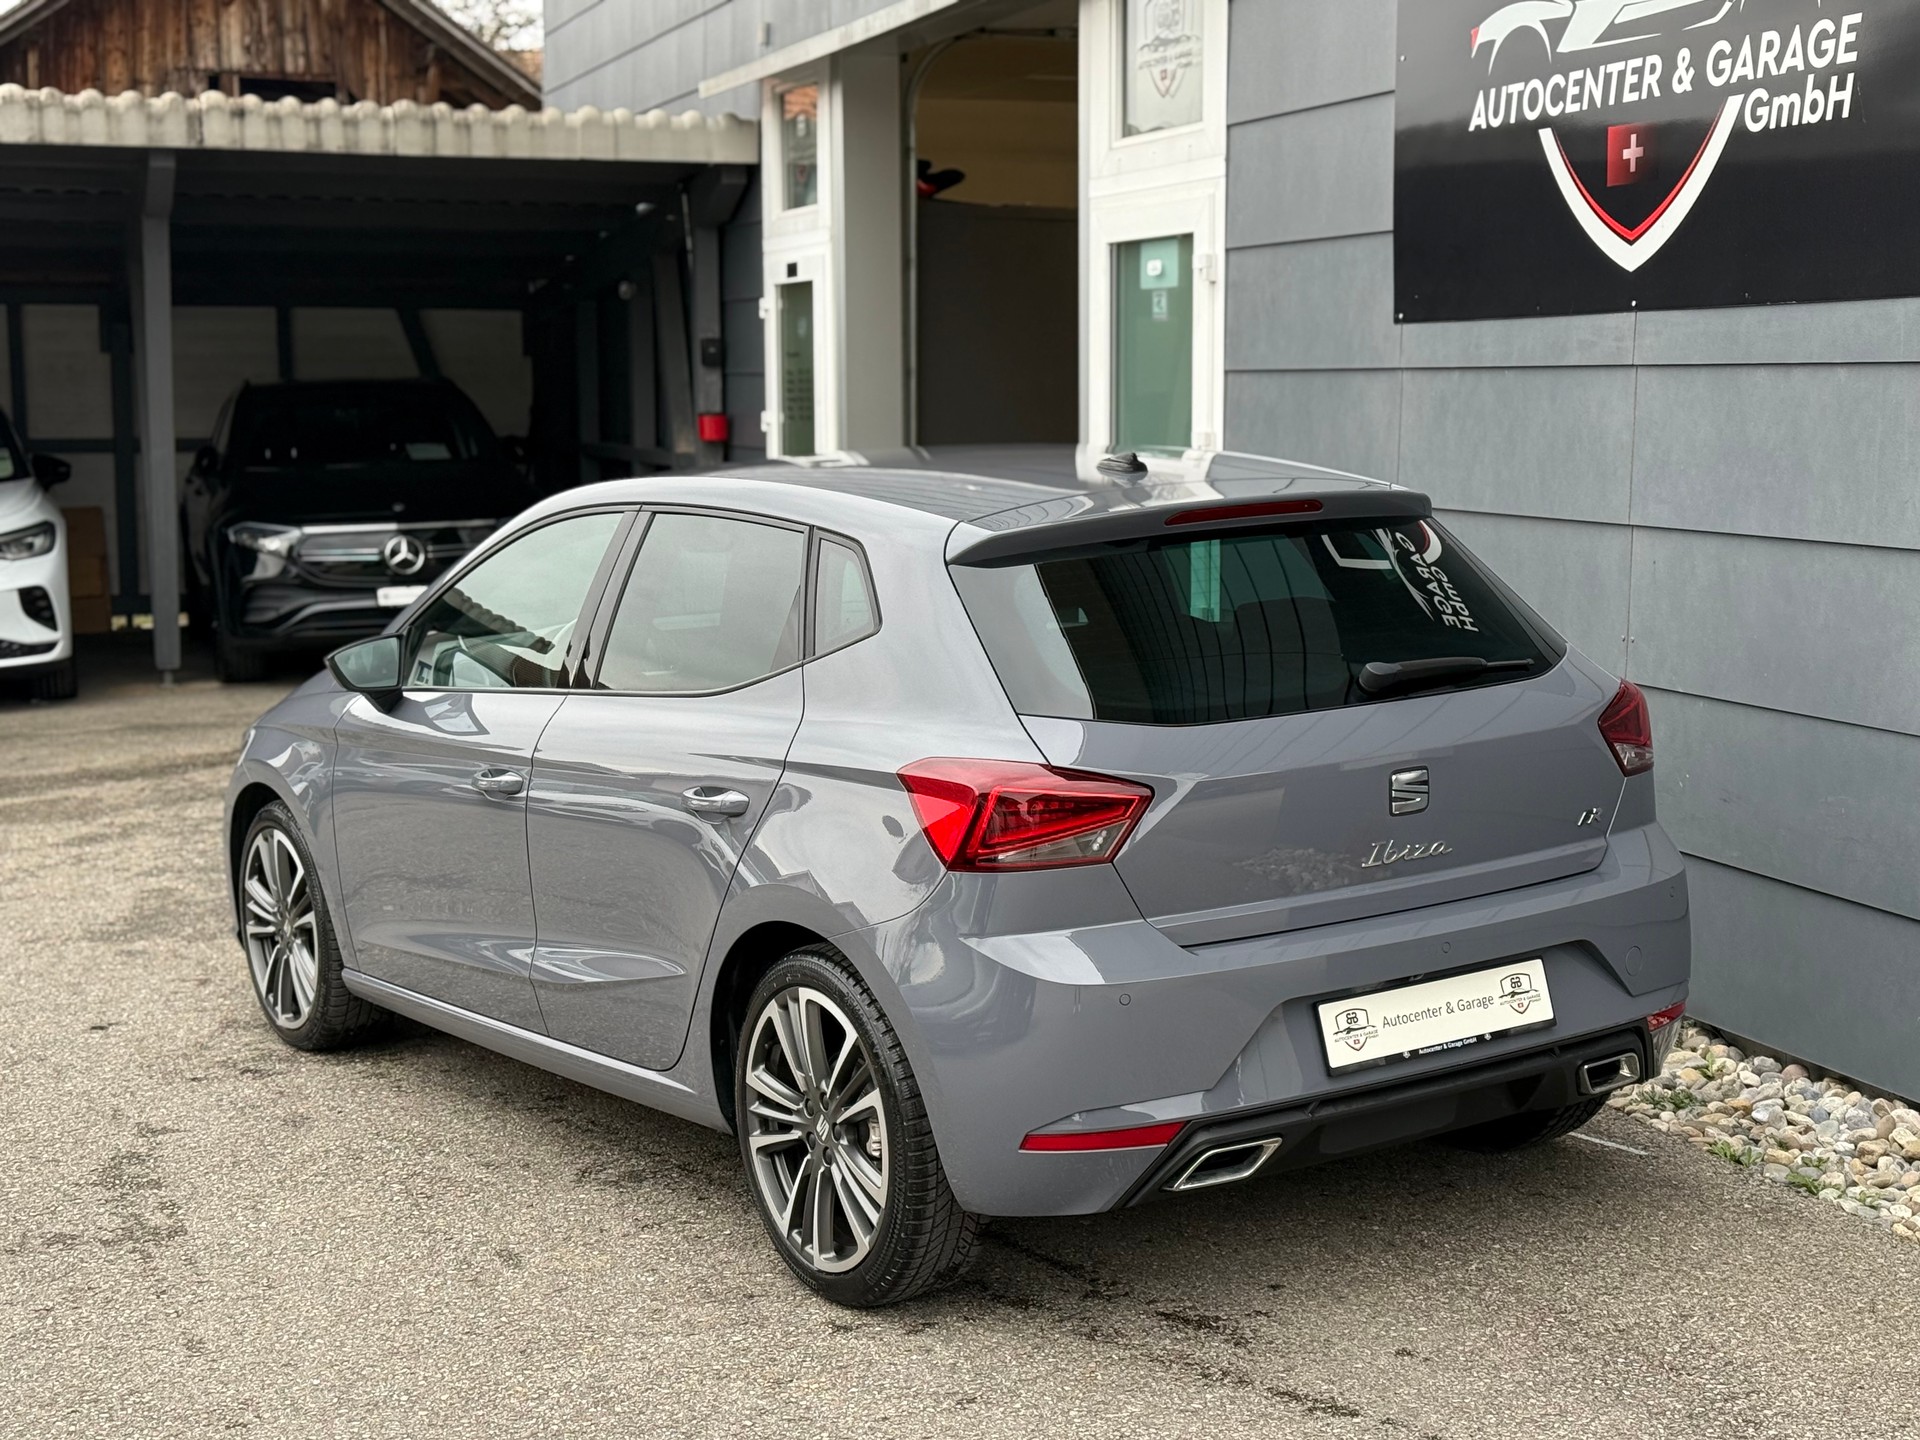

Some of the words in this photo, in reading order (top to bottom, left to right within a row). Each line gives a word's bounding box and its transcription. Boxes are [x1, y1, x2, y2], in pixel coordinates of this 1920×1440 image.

[1468, 54, 1662, 132] AUTOCENTER
[1671, 47, 1695, 94] &
[1706, 12, 1863, 87] GARAGE
[1744, 72, 1855, 132] GmbH
[1361, 839, 1453, 868] Ibiza
[1382, 1006, 1443, 1029] Autocenter
[1445, 1001, 1455, 1014] &
[1457, 995, 1495, 1010] Garage
